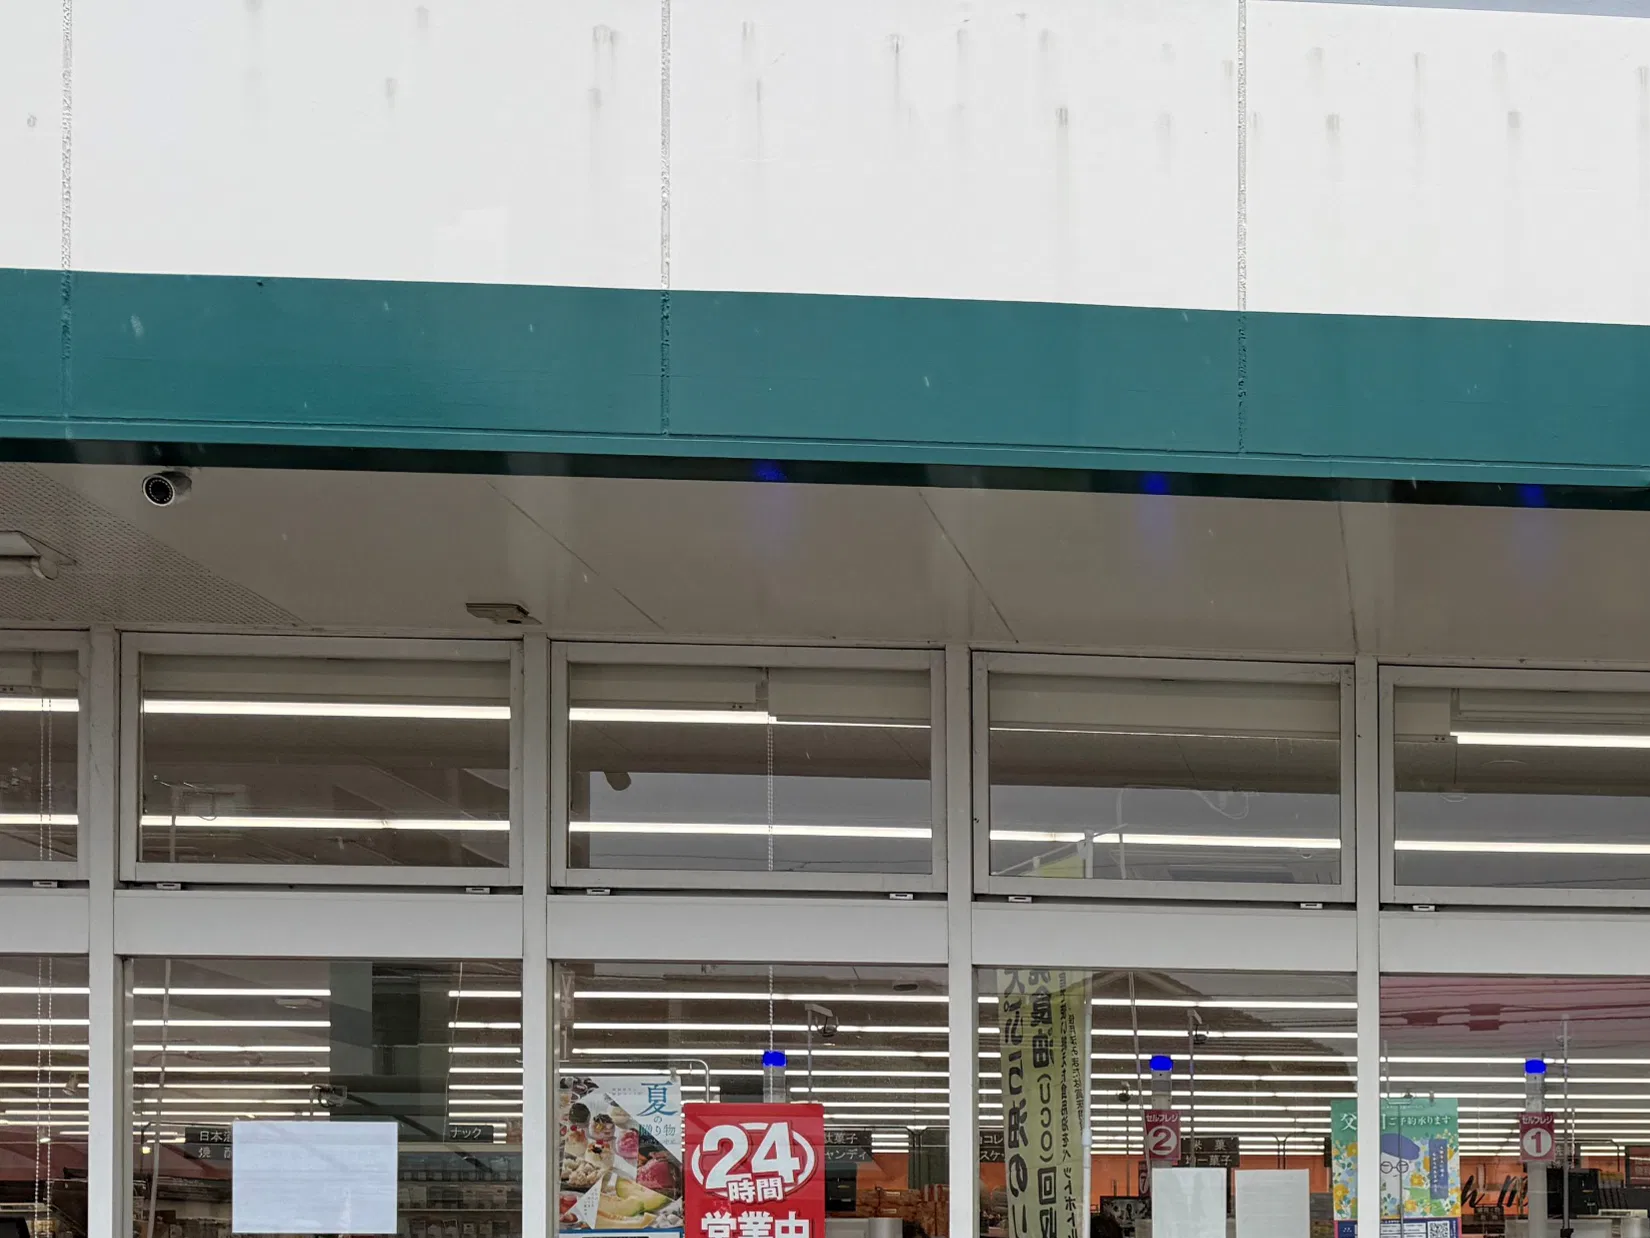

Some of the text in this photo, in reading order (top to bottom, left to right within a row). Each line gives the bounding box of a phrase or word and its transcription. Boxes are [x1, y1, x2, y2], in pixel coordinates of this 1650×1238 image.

[636, 1081, 678, 1117] 夏
[1146, 1114, 1178, 1123] セルフレジ
[1152, 1128, 1172, 1150] 2
[1531, 1131, 1542, 1154] 1
[703, 1122, 800, 1189] 24
[727, 1176, 784, 1202] 時間
